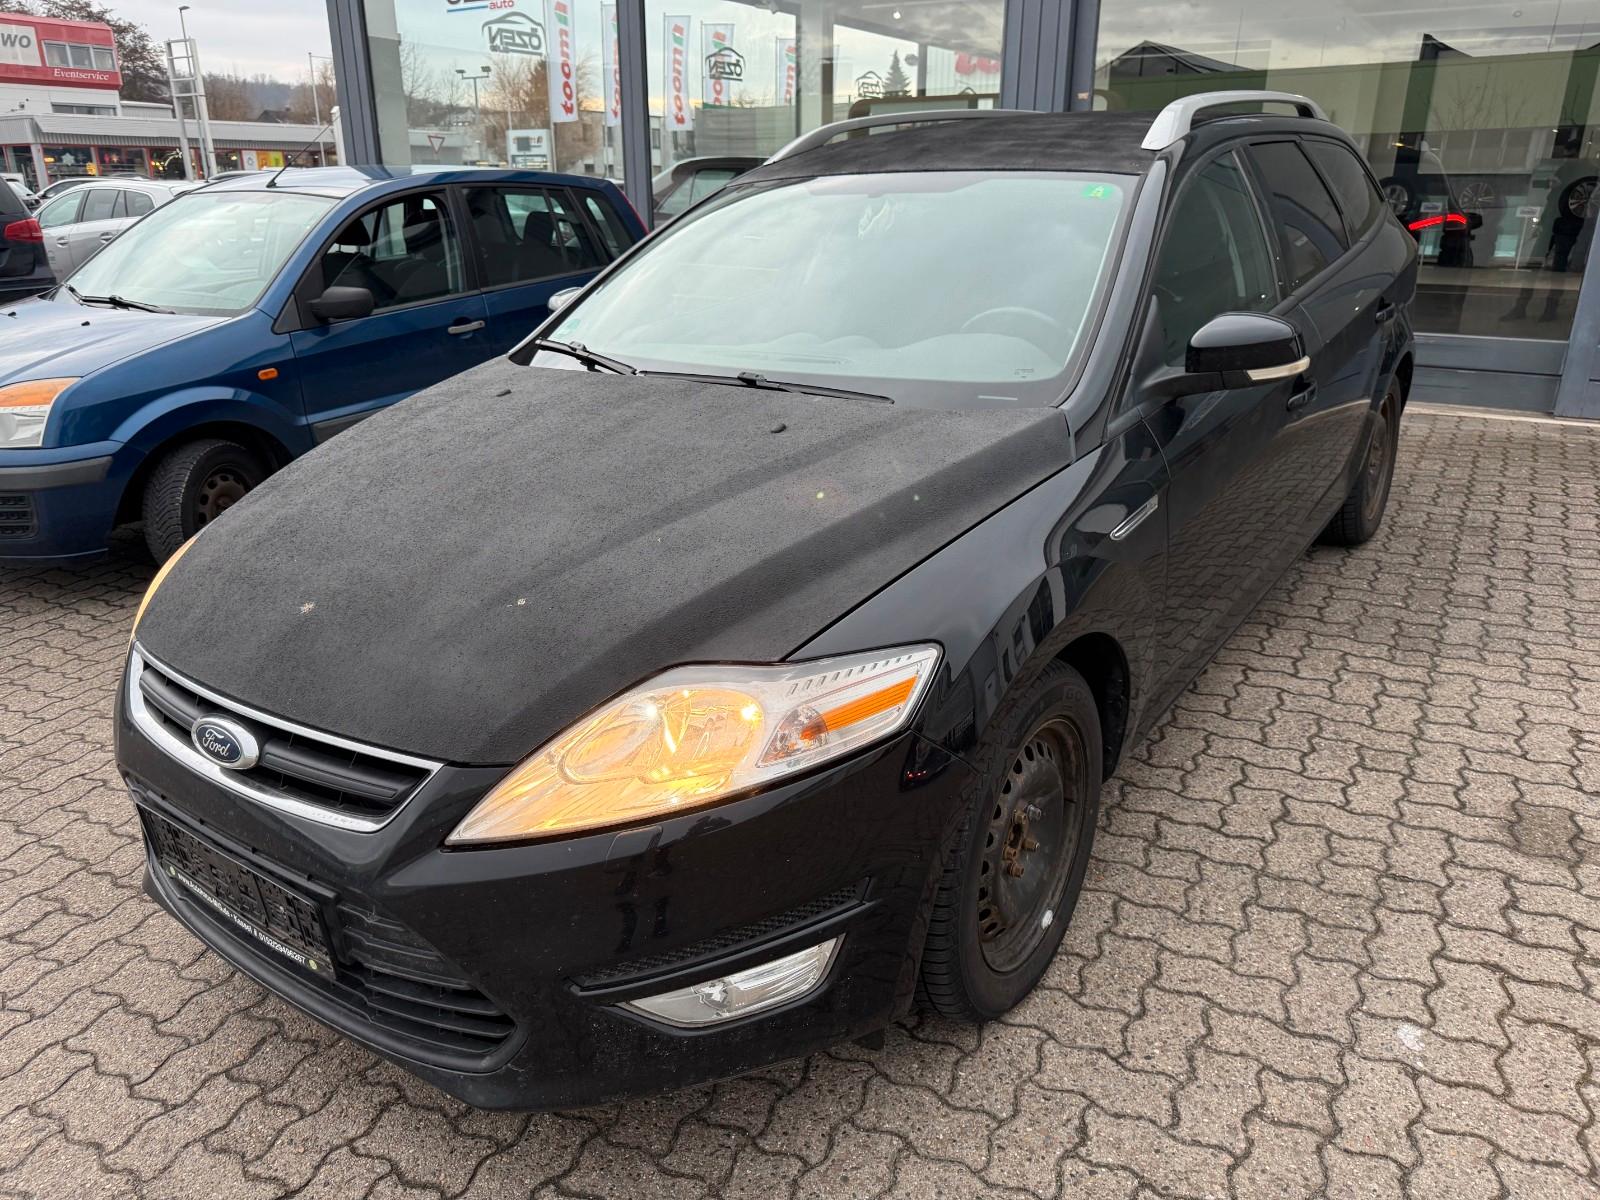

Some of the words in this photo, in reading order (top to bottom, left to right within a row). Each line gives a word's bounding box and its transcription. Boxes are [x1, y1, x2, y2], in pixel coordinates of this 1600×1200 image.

[489, 0, 515, 9] auto
[54, 68, 110, 81] Eventservice
[559, 28, 574, 115] toom
[673, 47, 685, 125] toom
[202, 728, 230, 756] Ford
